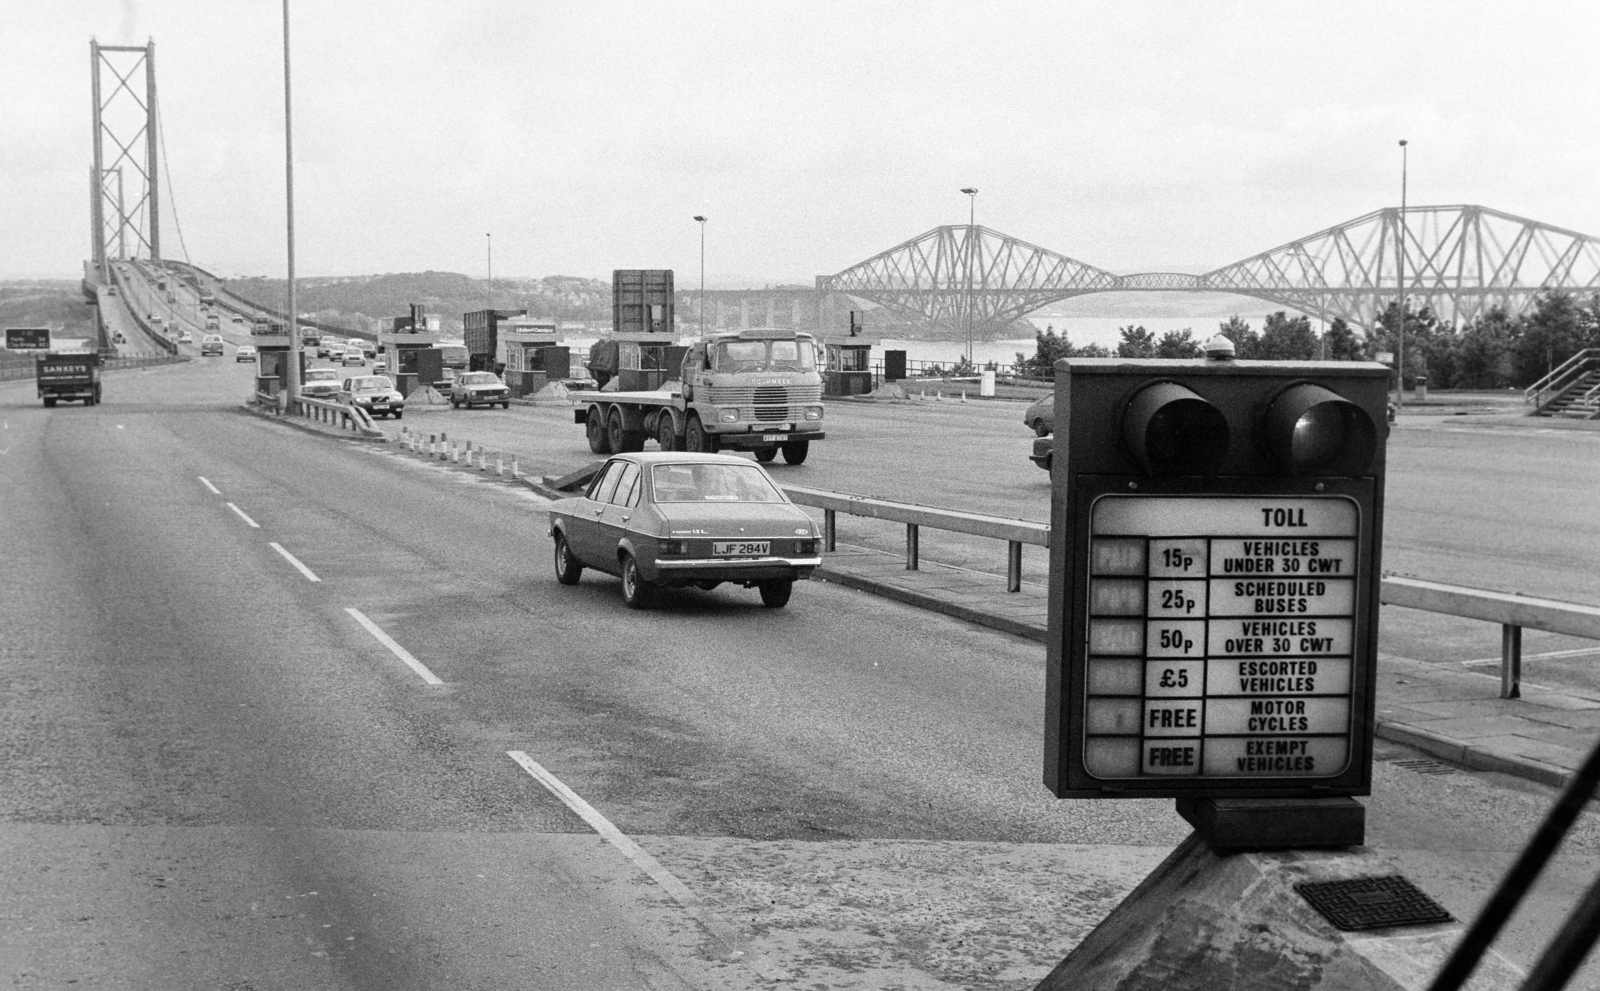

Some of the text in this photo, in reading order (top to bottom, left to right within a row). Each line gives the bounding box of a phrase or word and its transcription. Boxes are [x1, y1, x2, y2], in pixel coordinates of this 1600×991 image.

[43, 365, 87, 373] SANKEYS
[1262, 508, 1308, 527] TOLL
[714, 543, 769, 555] LJF 284V
[1243, 541, 1319, 556] VEHICLES
[1163, 549, 1193, 571] 15p
[1224, 558, 1343, 573] UNDER 30 CWT
[1234, 582, 1326, 597] SCHEDULED
[1162, 590, 1195, 614] 25p
[1254, 598, 1307, 613] BUSES
[1242, 621, 1317, 636] VEHICLES
[1160, 629, 1193, 654] 50p
[1225, 638, 1334, 653] OVER 30 CWT
[1239, 661, 1317, 676] ESCORTED
[1159, 668, 1188, 688] £5
[1240, 677, 1315, 692] VEHICLES
[1250, 700, 1305, 715] MOTOR
[1149, 708, 1197, 728] FREE
[1248, 716, 1308, 731] CYCLES
[1246, 741, 1308, 755] EXEMPT
[1149, 747, 1194, 767] FREE
[1237, 756, 1315, 771] VEHICLES
